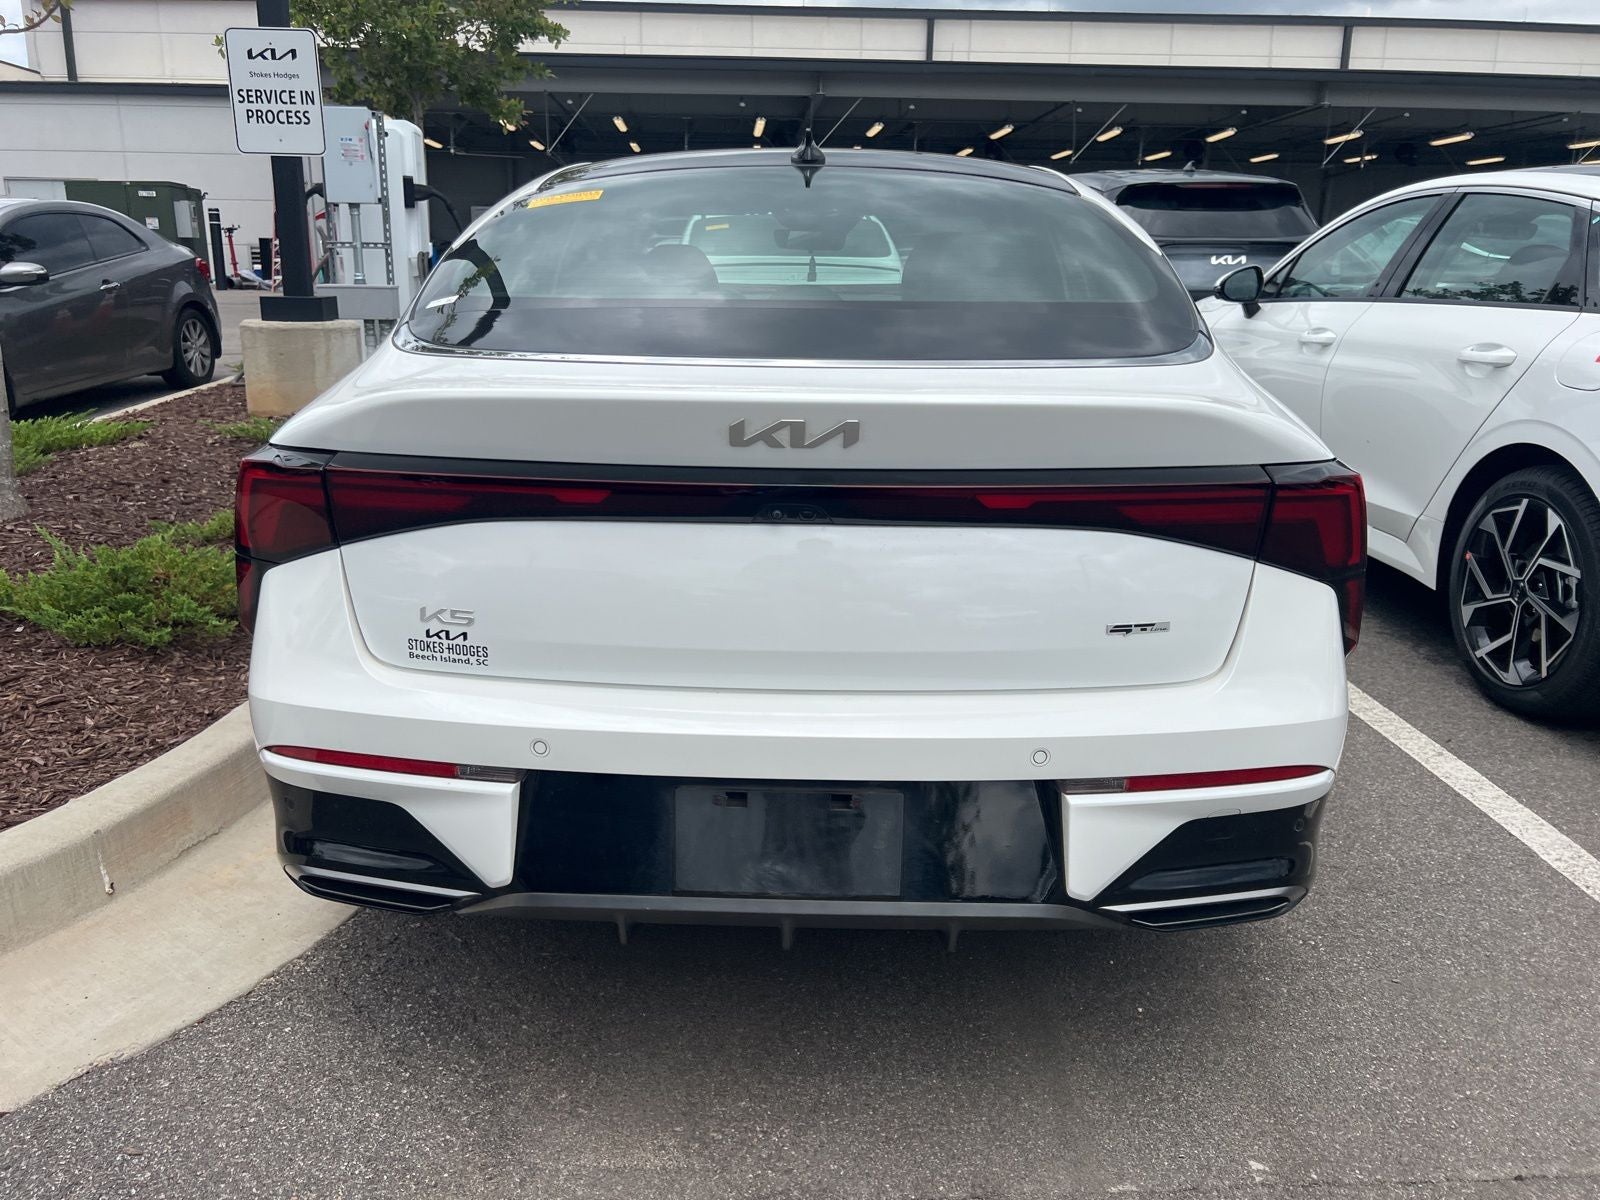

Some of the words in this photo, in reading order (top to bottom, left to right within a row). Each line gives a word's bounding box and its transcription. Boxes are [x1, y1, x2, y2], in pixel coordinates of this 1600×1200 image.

[247, 48, 297, 61] KIA
[249, 71, 271, 79] Stokes
[273, 72, 300, 80] Hodges
[237, 88, 297, 105] SERVICE
[300, 90, 315, 105] IN
[246, 109, 311, 125] PROCESS
[1210, 255, 1247, 265] KIA
[729, 418, 860, 449] KIA
[419, 606, 475, 627] K5
[425, 628, 468, 642] KIA
[408, 652, 438, 662] Beech
[440, 655, 474, 666] Island,
[475, 659, 489, 667] SC
